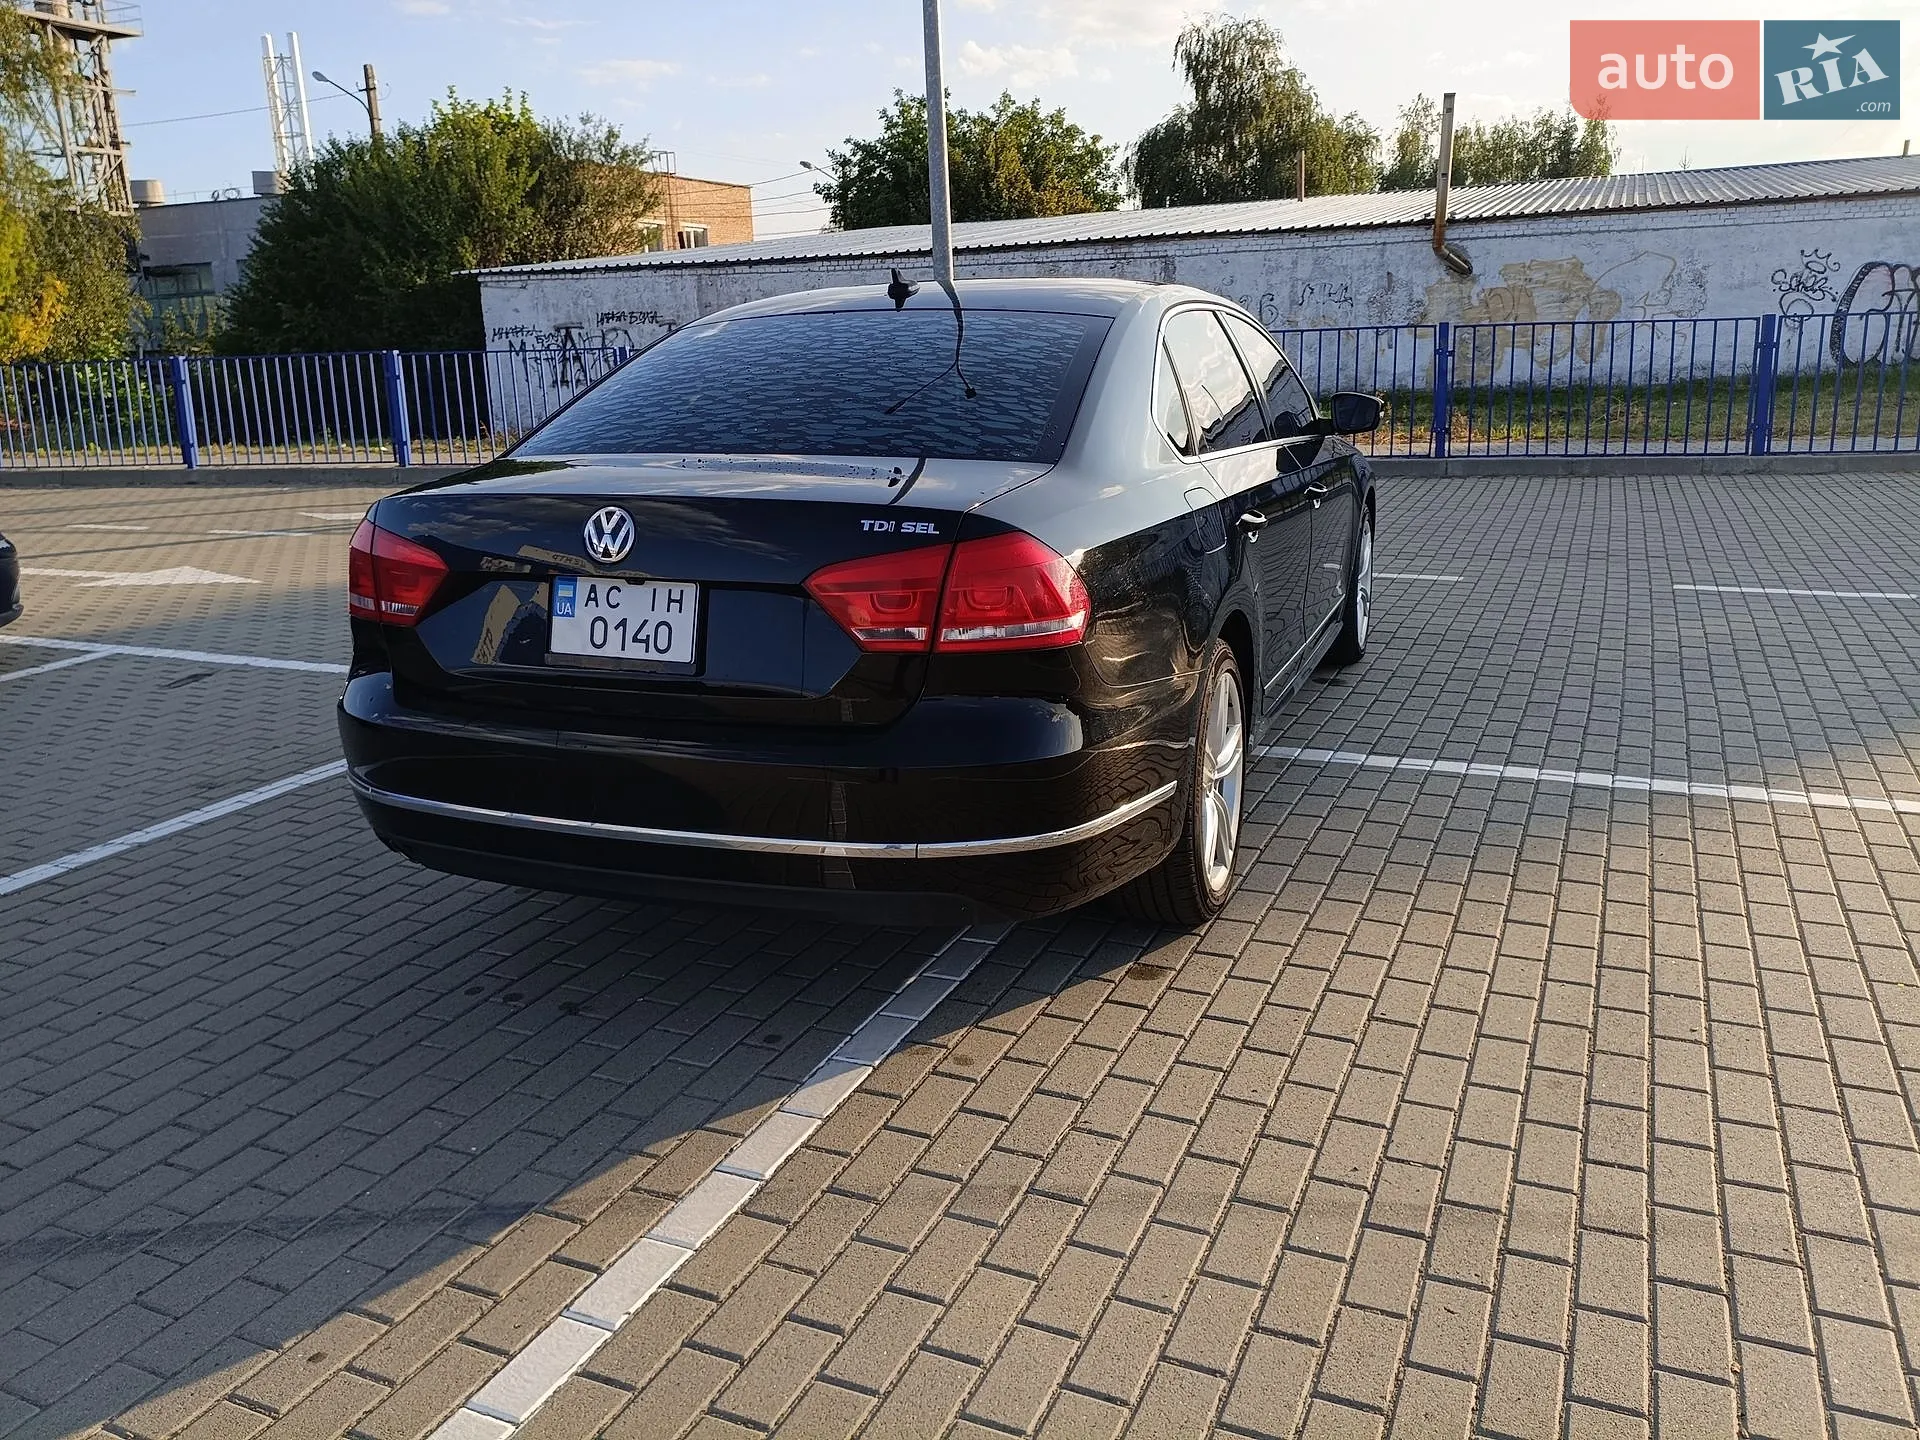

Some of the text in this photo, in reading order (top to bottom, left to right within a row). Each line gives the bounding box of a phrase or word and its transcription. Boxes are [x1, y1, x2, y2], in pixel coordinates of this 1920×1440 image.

[861, 519, 940, 535] TDI SEL
[556, 602, 573, 616] UA
[585, 584, 685, 614] AC IH
[589, 615, 673, 655] 0140
